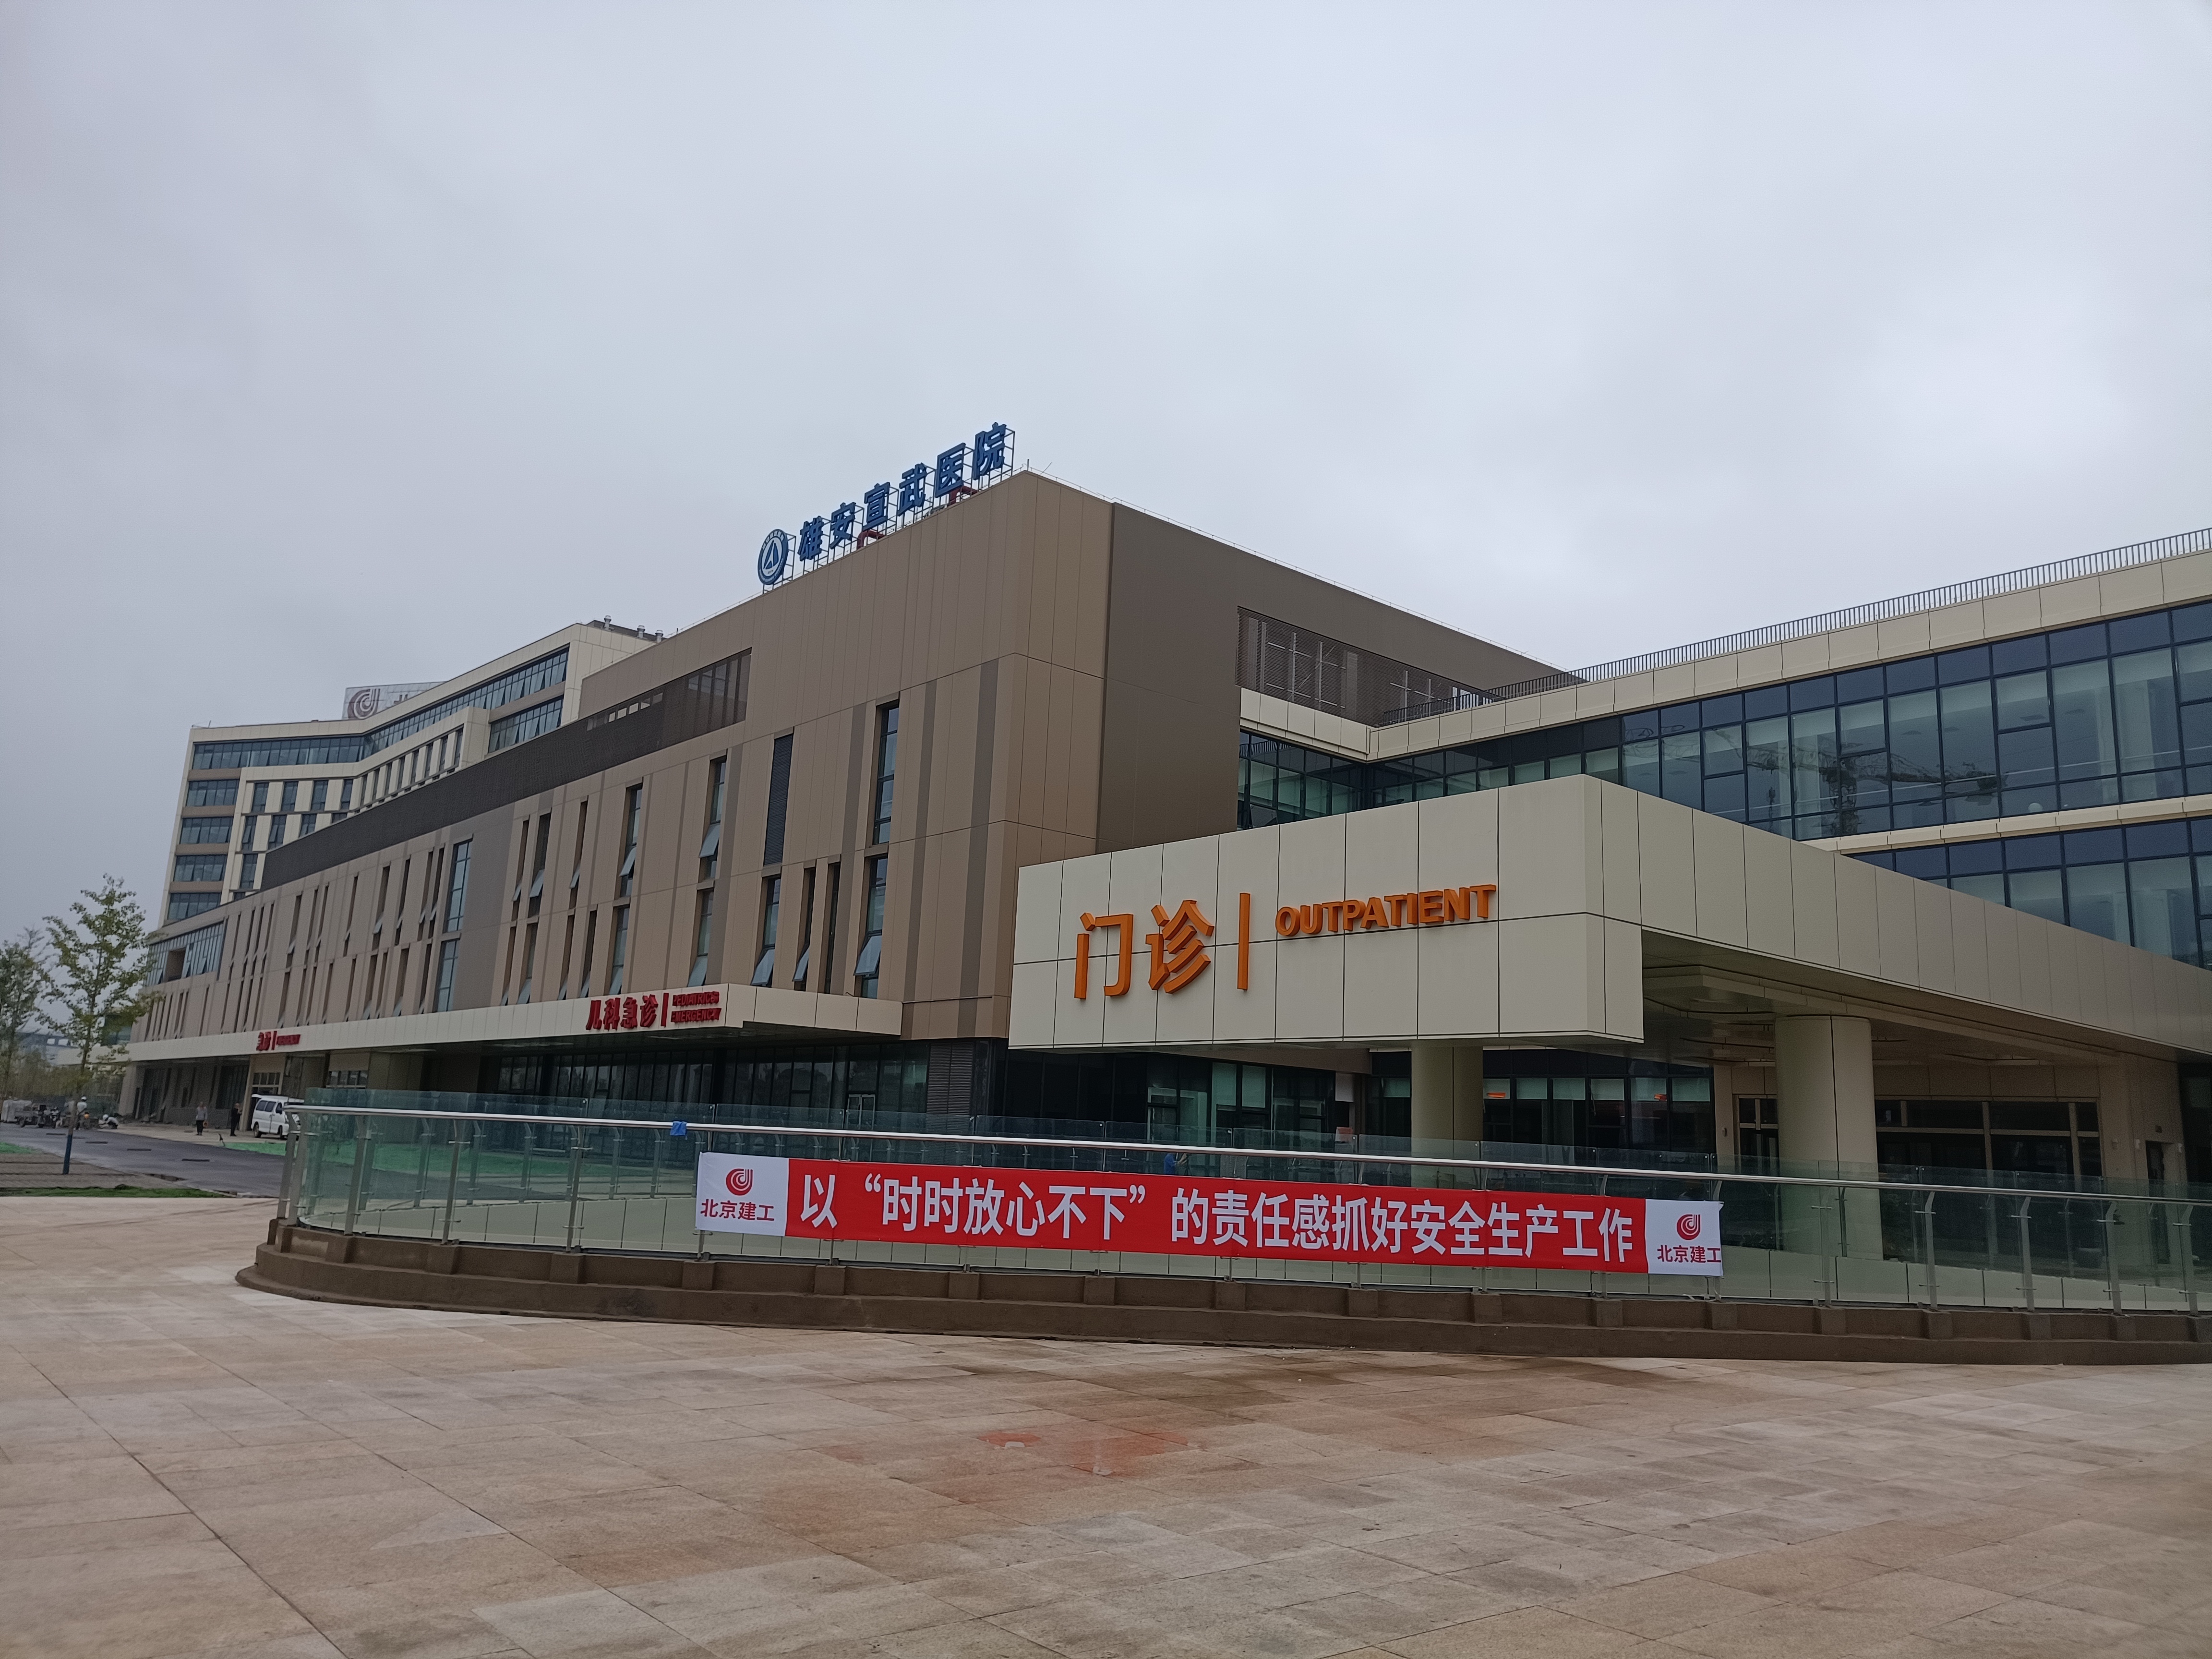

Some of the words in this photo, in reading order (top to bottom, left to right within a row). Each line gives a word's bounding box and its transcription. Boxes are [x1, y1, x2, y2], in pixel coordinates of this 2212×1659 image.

[797, 421, 1007, 562] 雄安宣武医院
[1075, 900, 1214, 1000] 门诊
[1275, 884, 1497, 937] OUTPATIENT
[673, 991, 720, 1006] PEDIATRICS
[586, 994, 659, 1030] 儿科急诊
[671, 1008, 721, 1022] EMERGENCY
[701, 1199, 774, 1222] 北京建工
[1657, 1244, 1722, 1263] 北京建工
